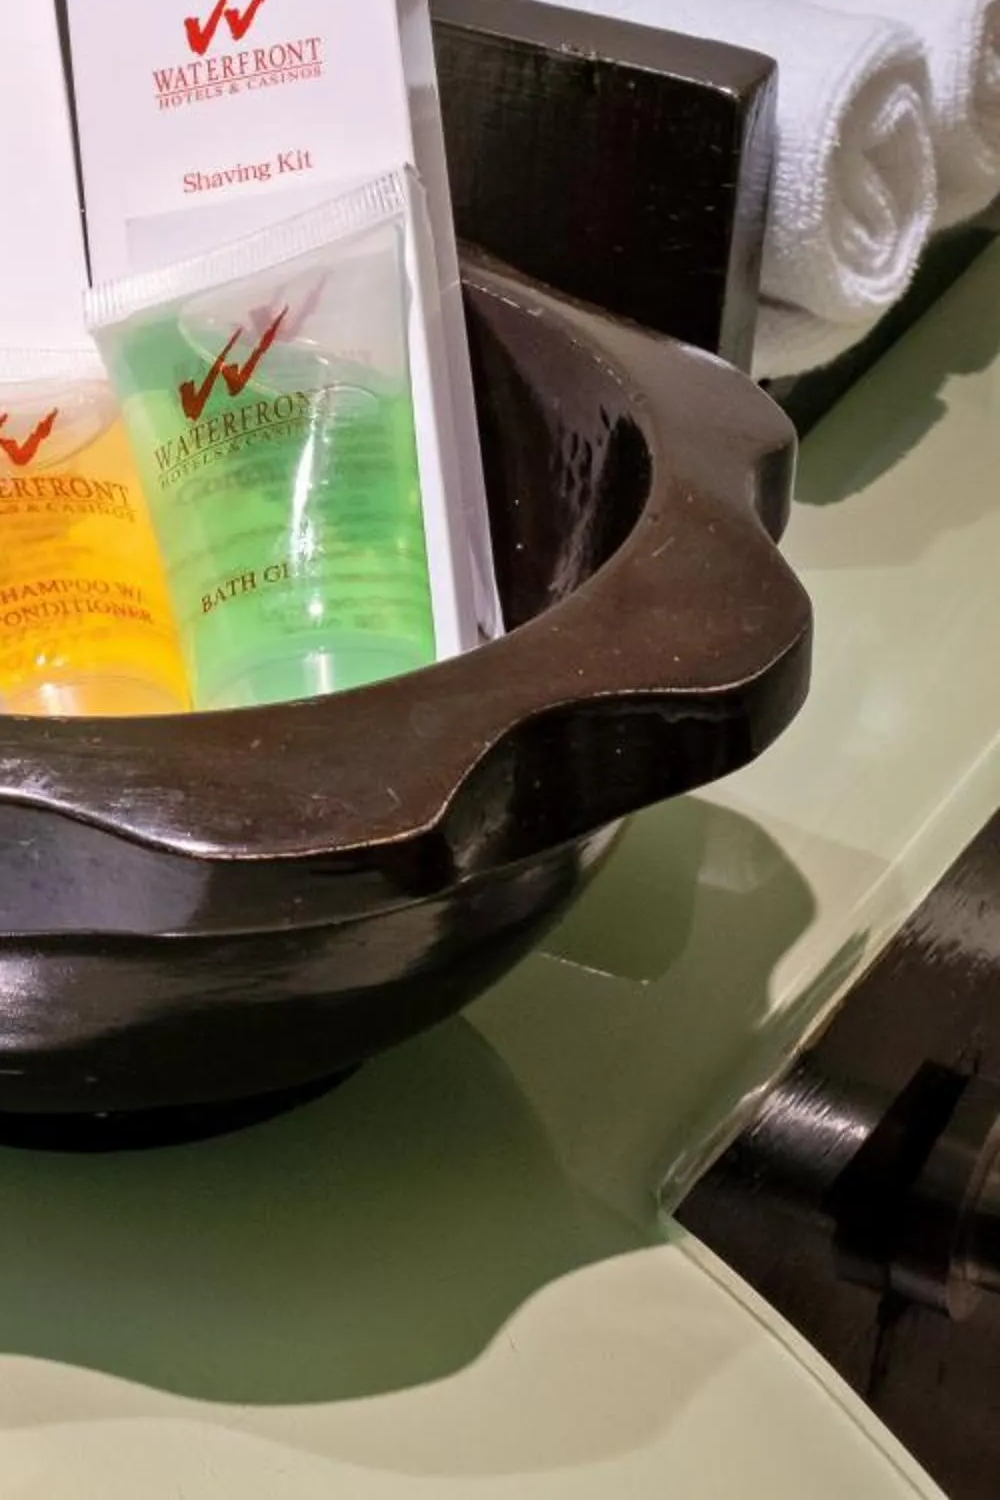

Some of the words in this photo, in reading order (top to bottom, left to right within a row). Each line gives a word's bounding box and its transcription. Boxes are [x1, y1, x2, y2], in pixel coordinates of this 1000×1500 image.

[152, 37, 322, 94] WATERFRONT
[157, 85, 223, 111] HOTELS
[228, 83, 241, 95] &
[246, 65, 322, 91] CASINOS
[183, 161, 271, 194] Shaving
[276, 149, 313, 174] Kit
[154, 391, 312, 471] WATERFRON
[47, 502, 138, 522] CASINOS
[200, 571, 257, 614] BATH
